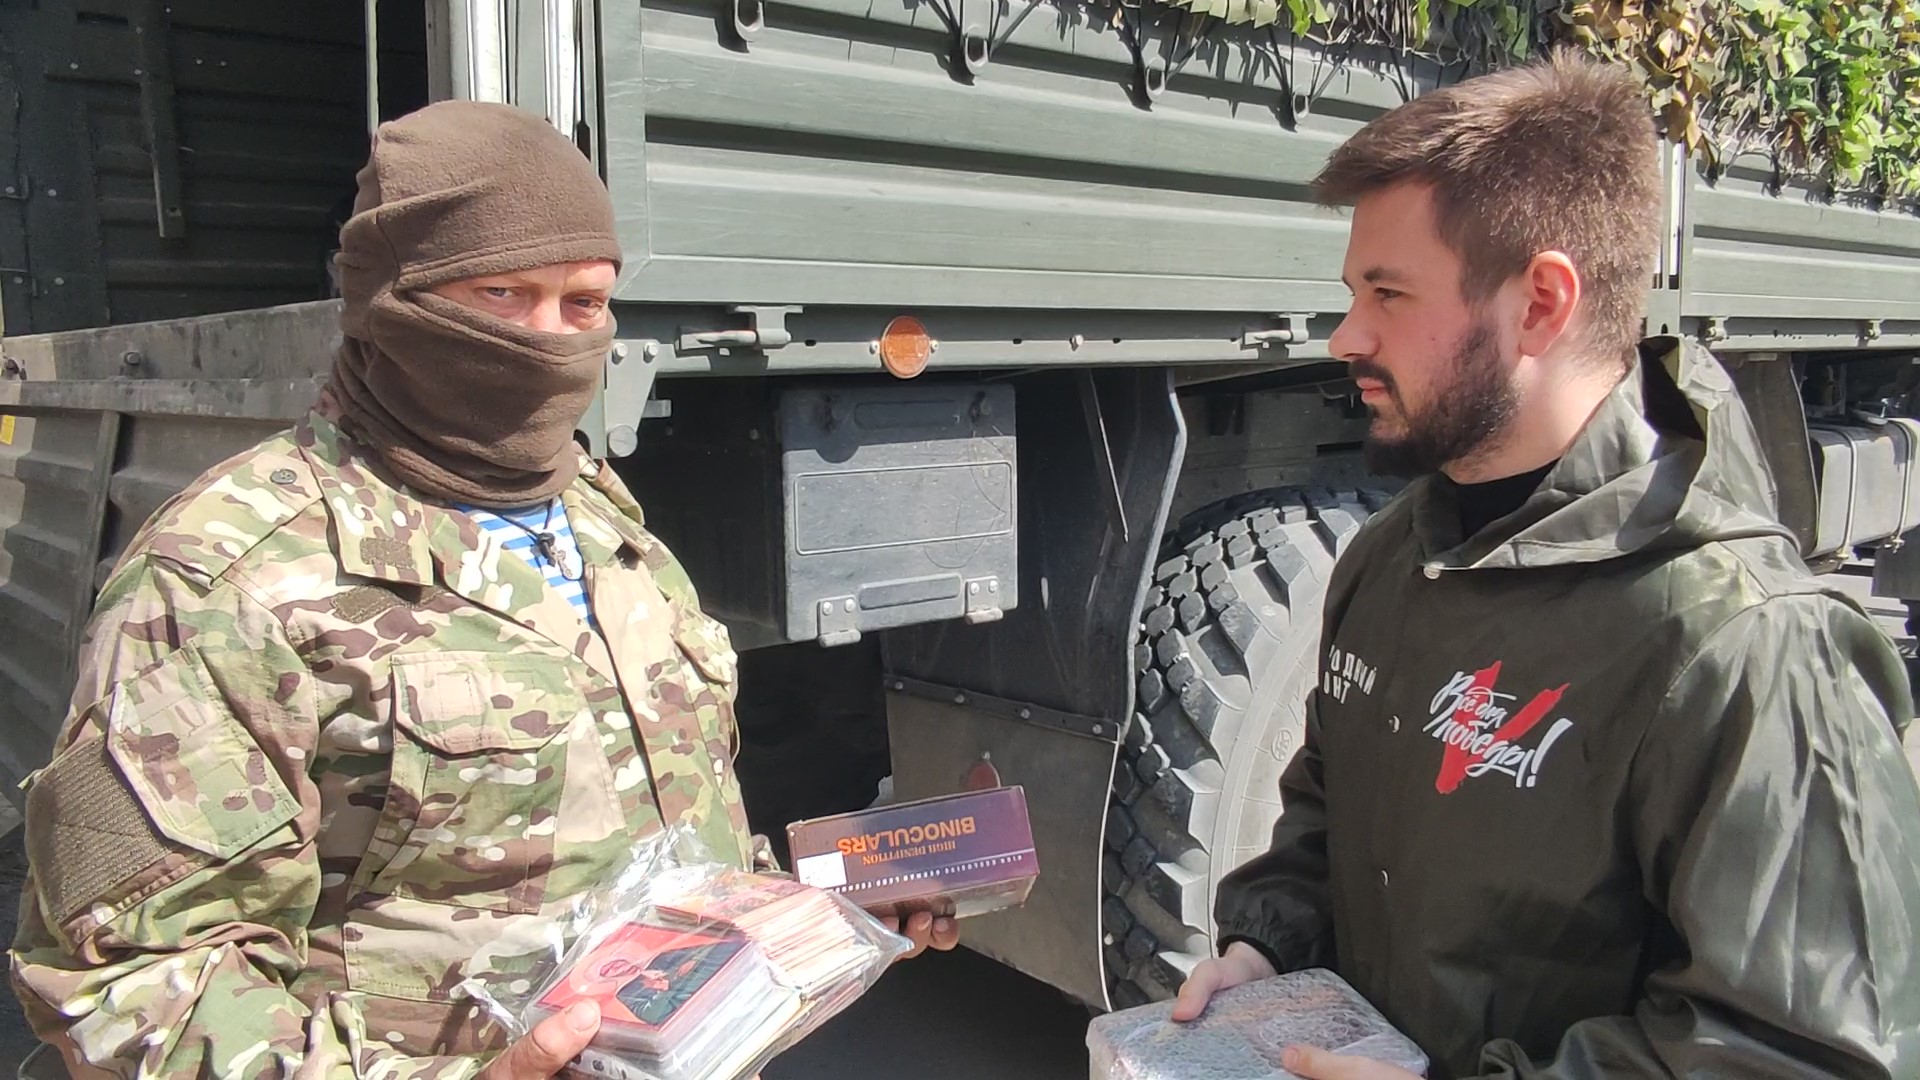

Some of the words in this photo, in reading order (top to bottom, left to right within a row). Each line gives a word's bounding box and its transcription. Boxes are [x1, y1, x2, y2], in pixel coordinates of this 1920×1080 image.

[1323, 671, 1351, 704] ОНТ
[838, 816, 976, 856] BINOCULARS
[929, 840, 956, 854] HIGH
